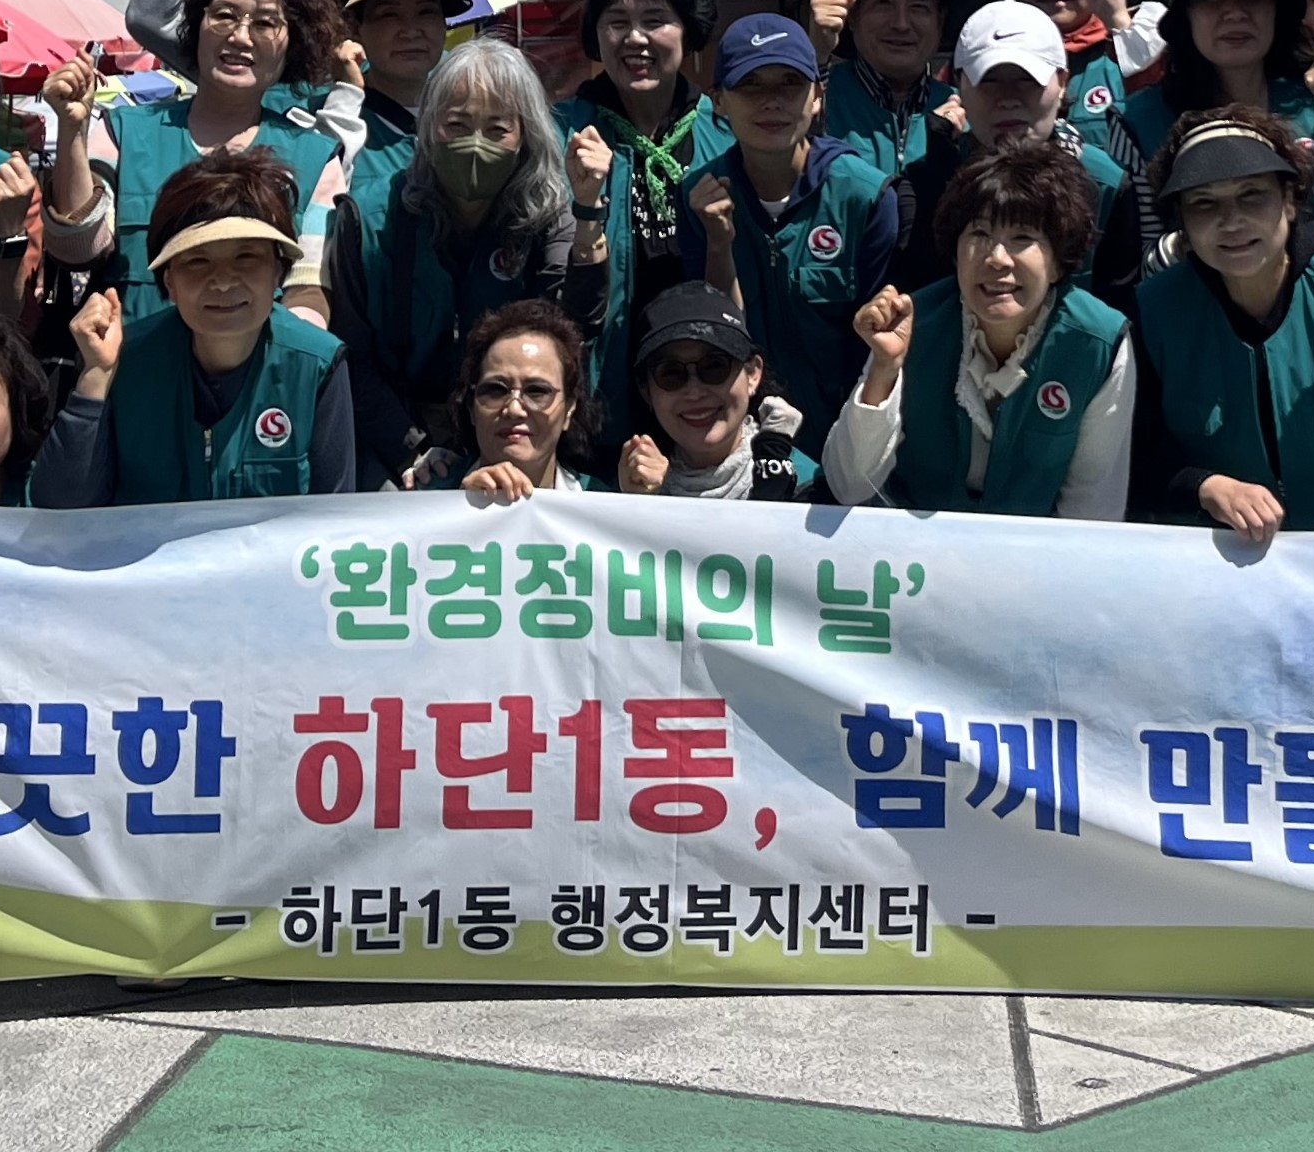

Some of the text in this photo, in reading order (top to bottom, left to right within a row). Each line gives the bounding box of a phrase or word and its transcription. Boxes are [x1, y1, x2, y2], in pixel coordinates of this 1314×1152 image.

[300, 539, 926, 654] ‘환경정비의 날’
[292, 694, 779, 852] 하단1동,
[839, 702, 1082, 837] 함께
[282, 885, 516, 956] 하단1동
[551, 882, 930, 955] 행정복지센터
